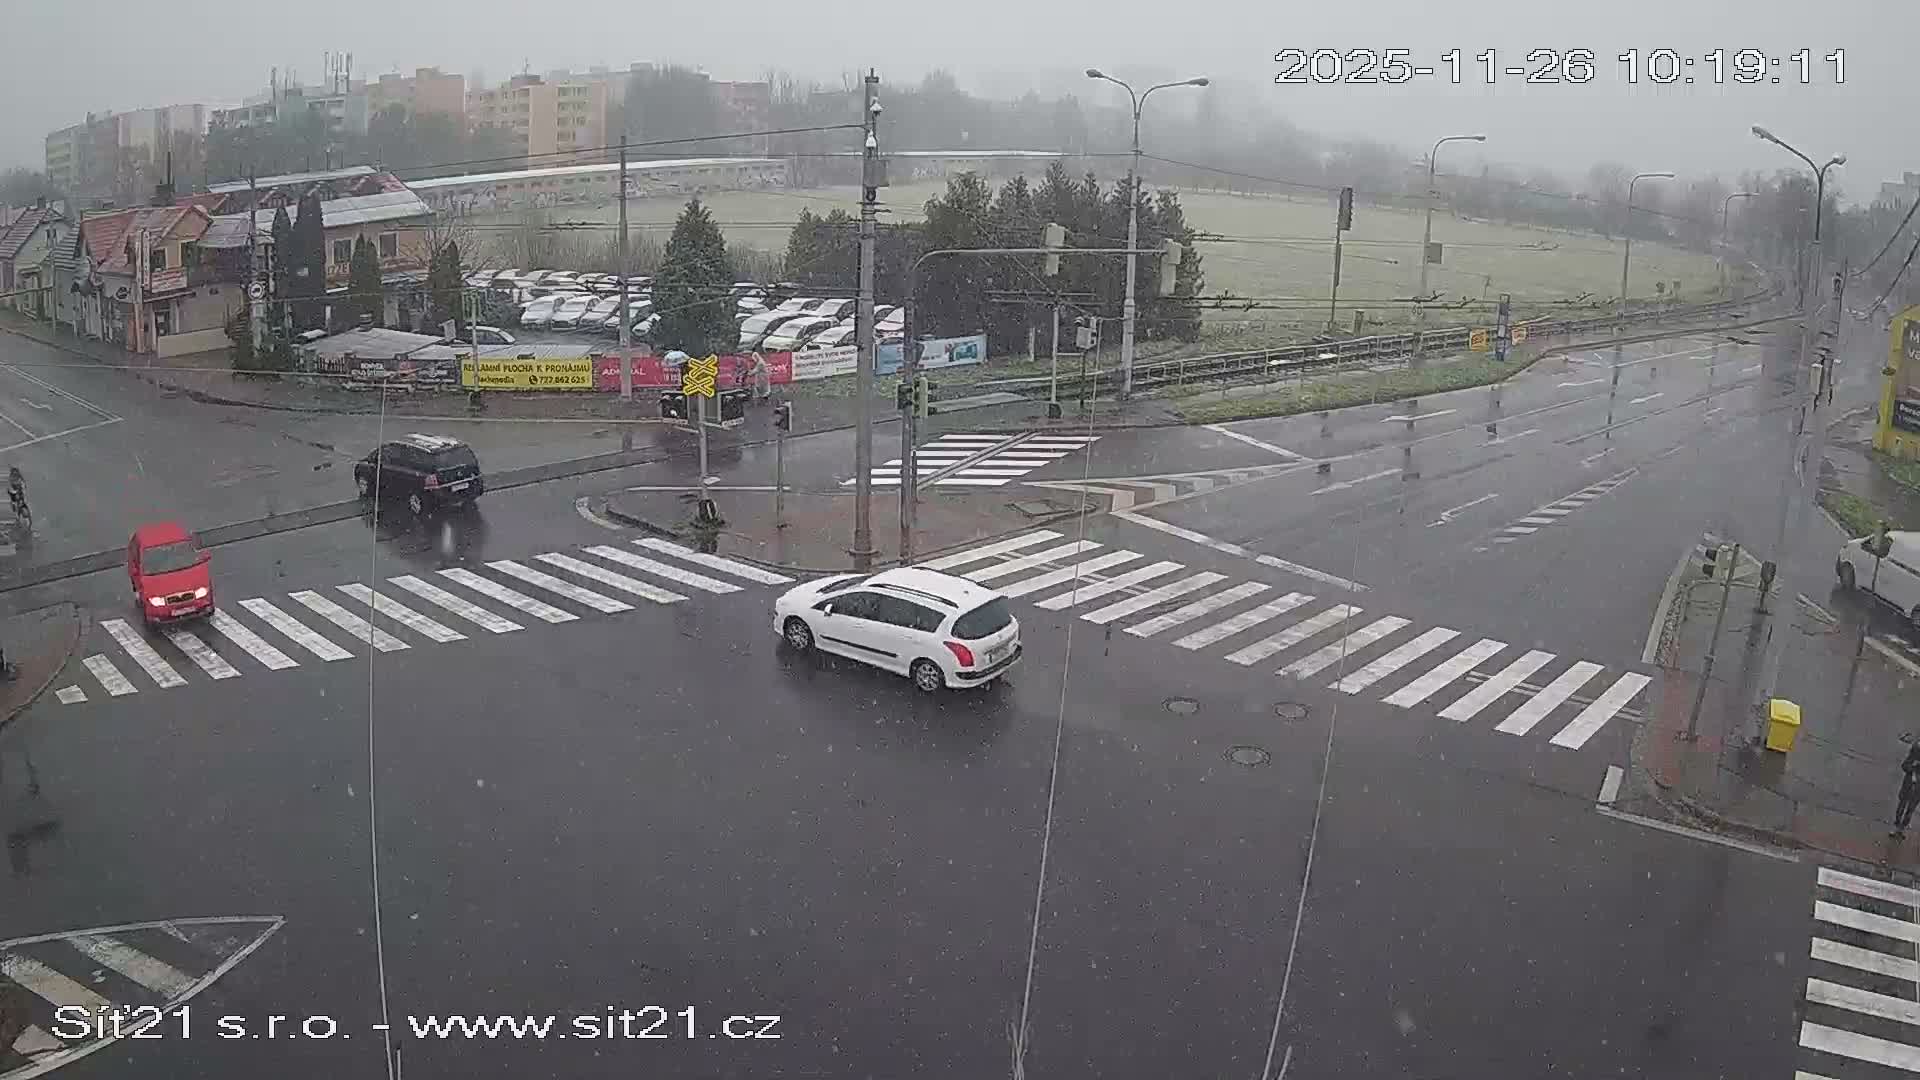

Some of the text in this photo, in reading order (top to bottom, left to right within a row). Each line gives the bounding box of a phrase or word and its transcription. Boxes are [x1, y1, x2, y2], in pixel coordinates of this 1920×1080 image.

[503, 363, 533, 372] PLOCHA
[537, 364, 544, 372] K
[545, 362, 590, 373] PRONÁJMU
[602, 367, 646, 377] ADRAL
[571, 375, 586, 384] 625
